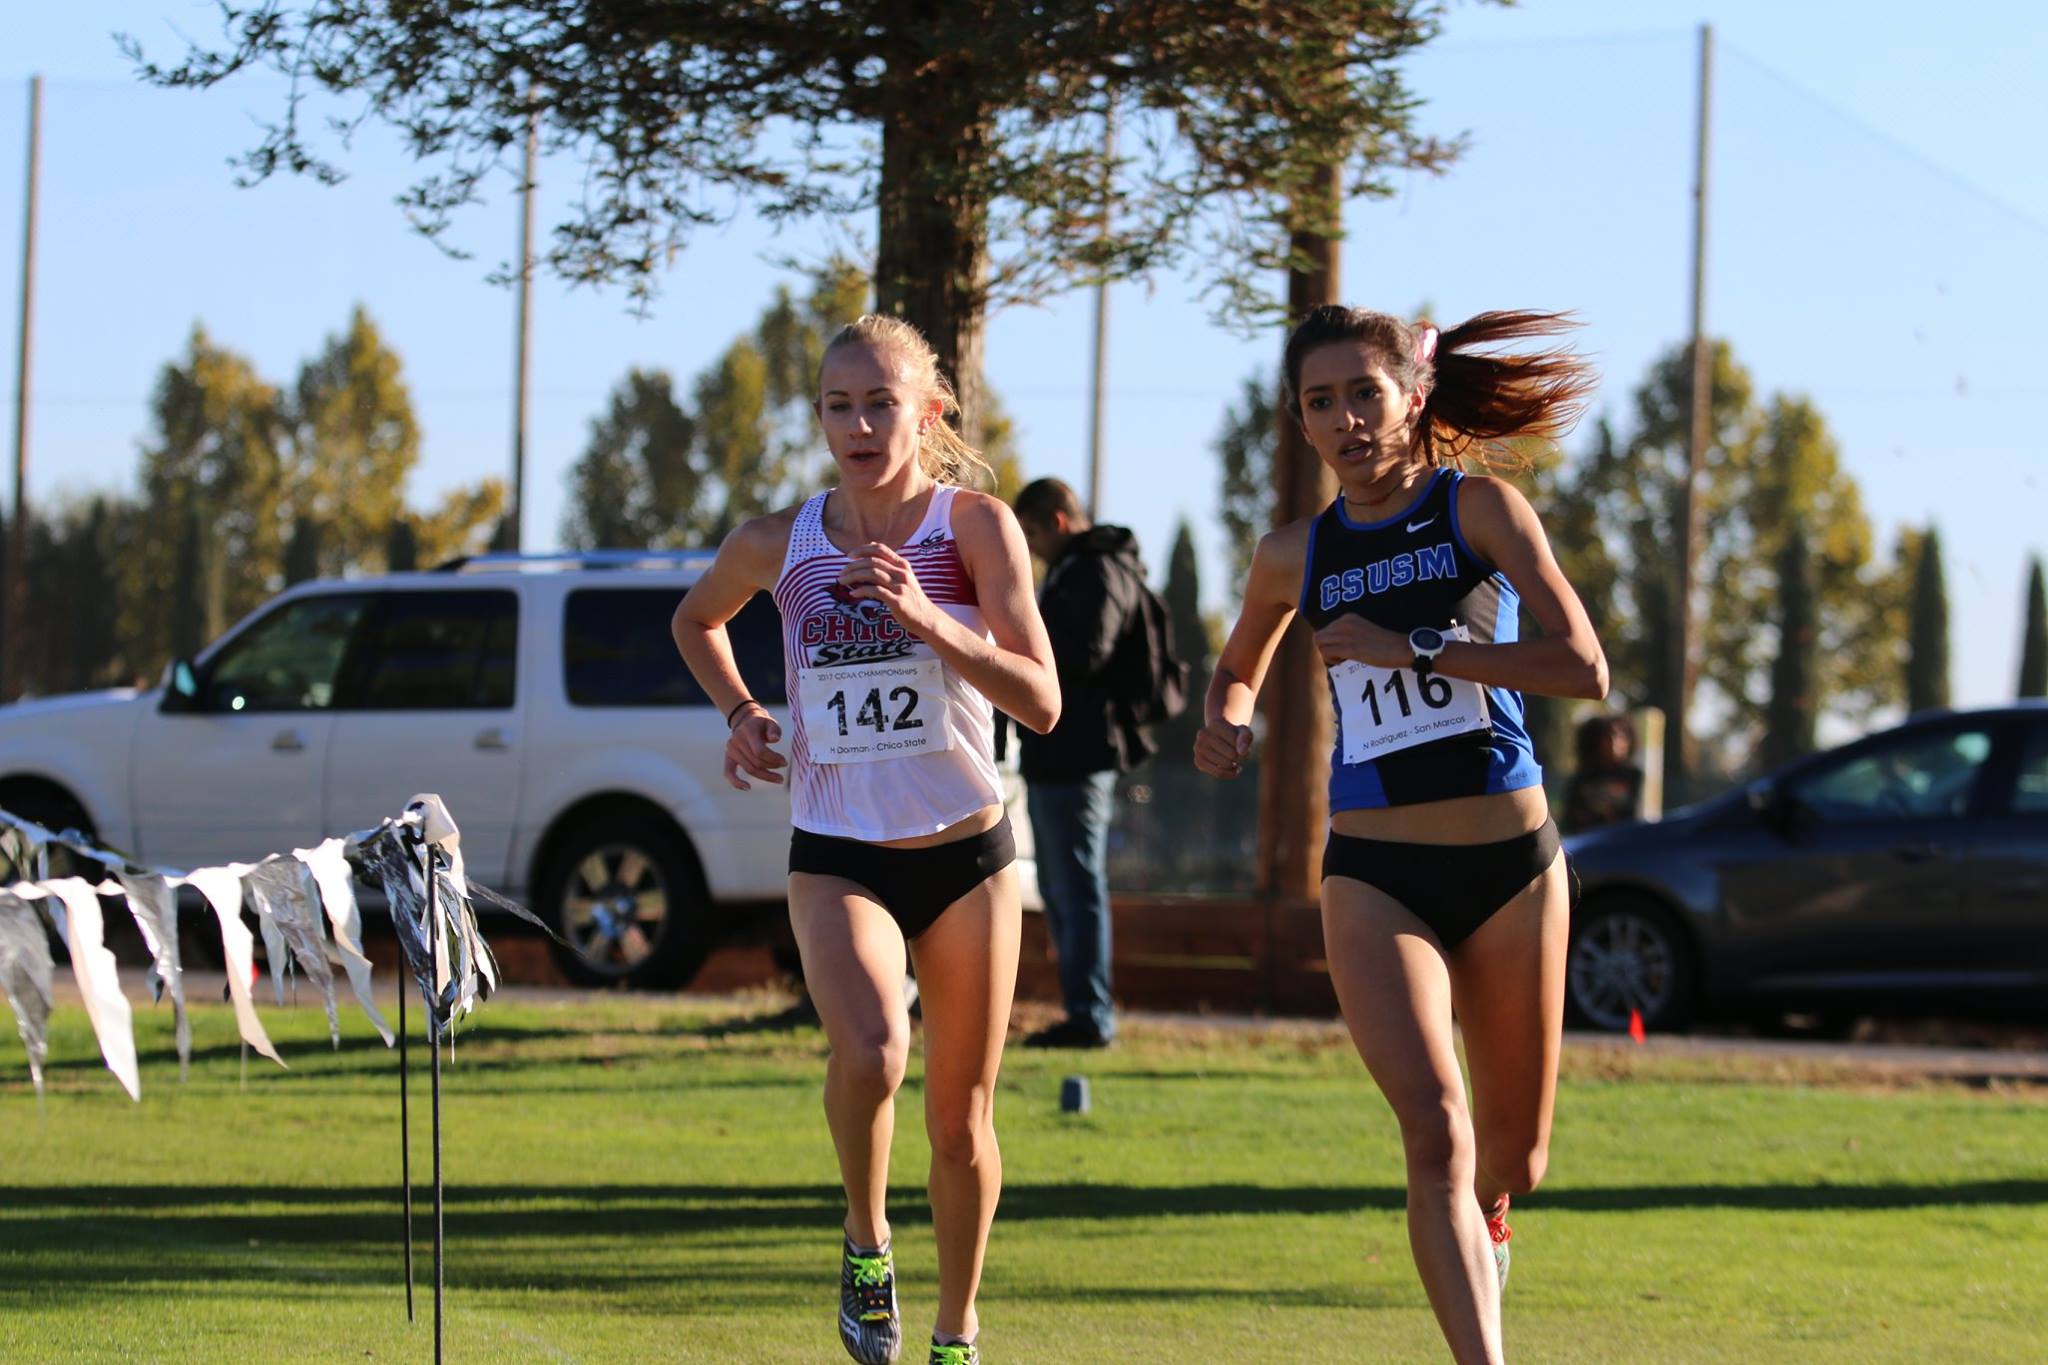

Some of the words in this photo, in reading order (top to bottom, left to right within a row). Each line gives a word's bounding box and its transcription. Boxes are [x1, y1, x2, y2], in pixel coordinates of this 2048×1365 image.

[1320, 543, 1458, 611] CSUSM
[800, 612, 926, 646] CHIC
[813, 639, 914, 667] State
[858, 668, 918, 679] CHAMPIONSHIPS
[827, 686, 924, 736] 142
[1361, 669, 1453, 726] 116
[876, 741, 903, 751] Chico
[904, 738, 927, 748] State
[1362, 742, 1370, 750] N
[1370, 730, 1408, 748] Rodriguez
[1414, 725, 1431, 735] San
[1433, 715, 1466, 729] Marcos
